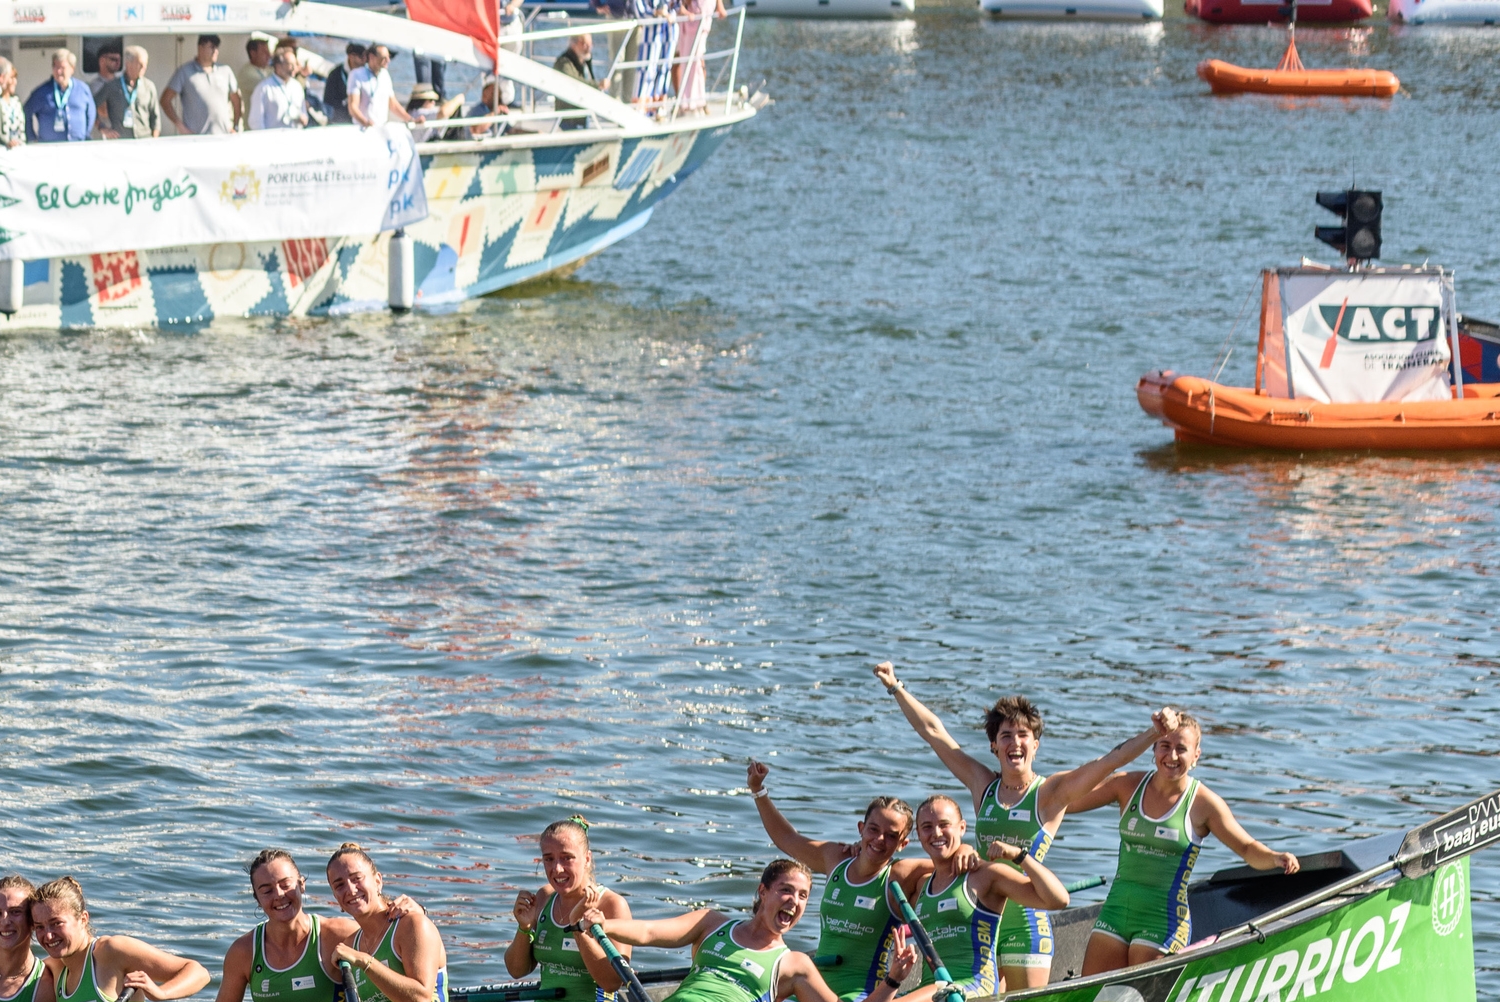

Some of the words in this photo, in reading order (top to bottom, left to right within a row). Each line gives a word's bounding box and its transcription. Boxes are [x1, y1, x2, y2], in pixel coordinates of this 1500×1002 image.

[35, 182, 61, 210] El
[63, 183, 120, 209] Corte
[1348, 306, 1435, 341] ACT
[979, 833, 1033, 847] bertako
[1035, 834, 1053, 863] BM
[1187, 845, 1201, 868] BM
[825, 915, 875, 935] bertako
[978, 919, 991, 945] BM
